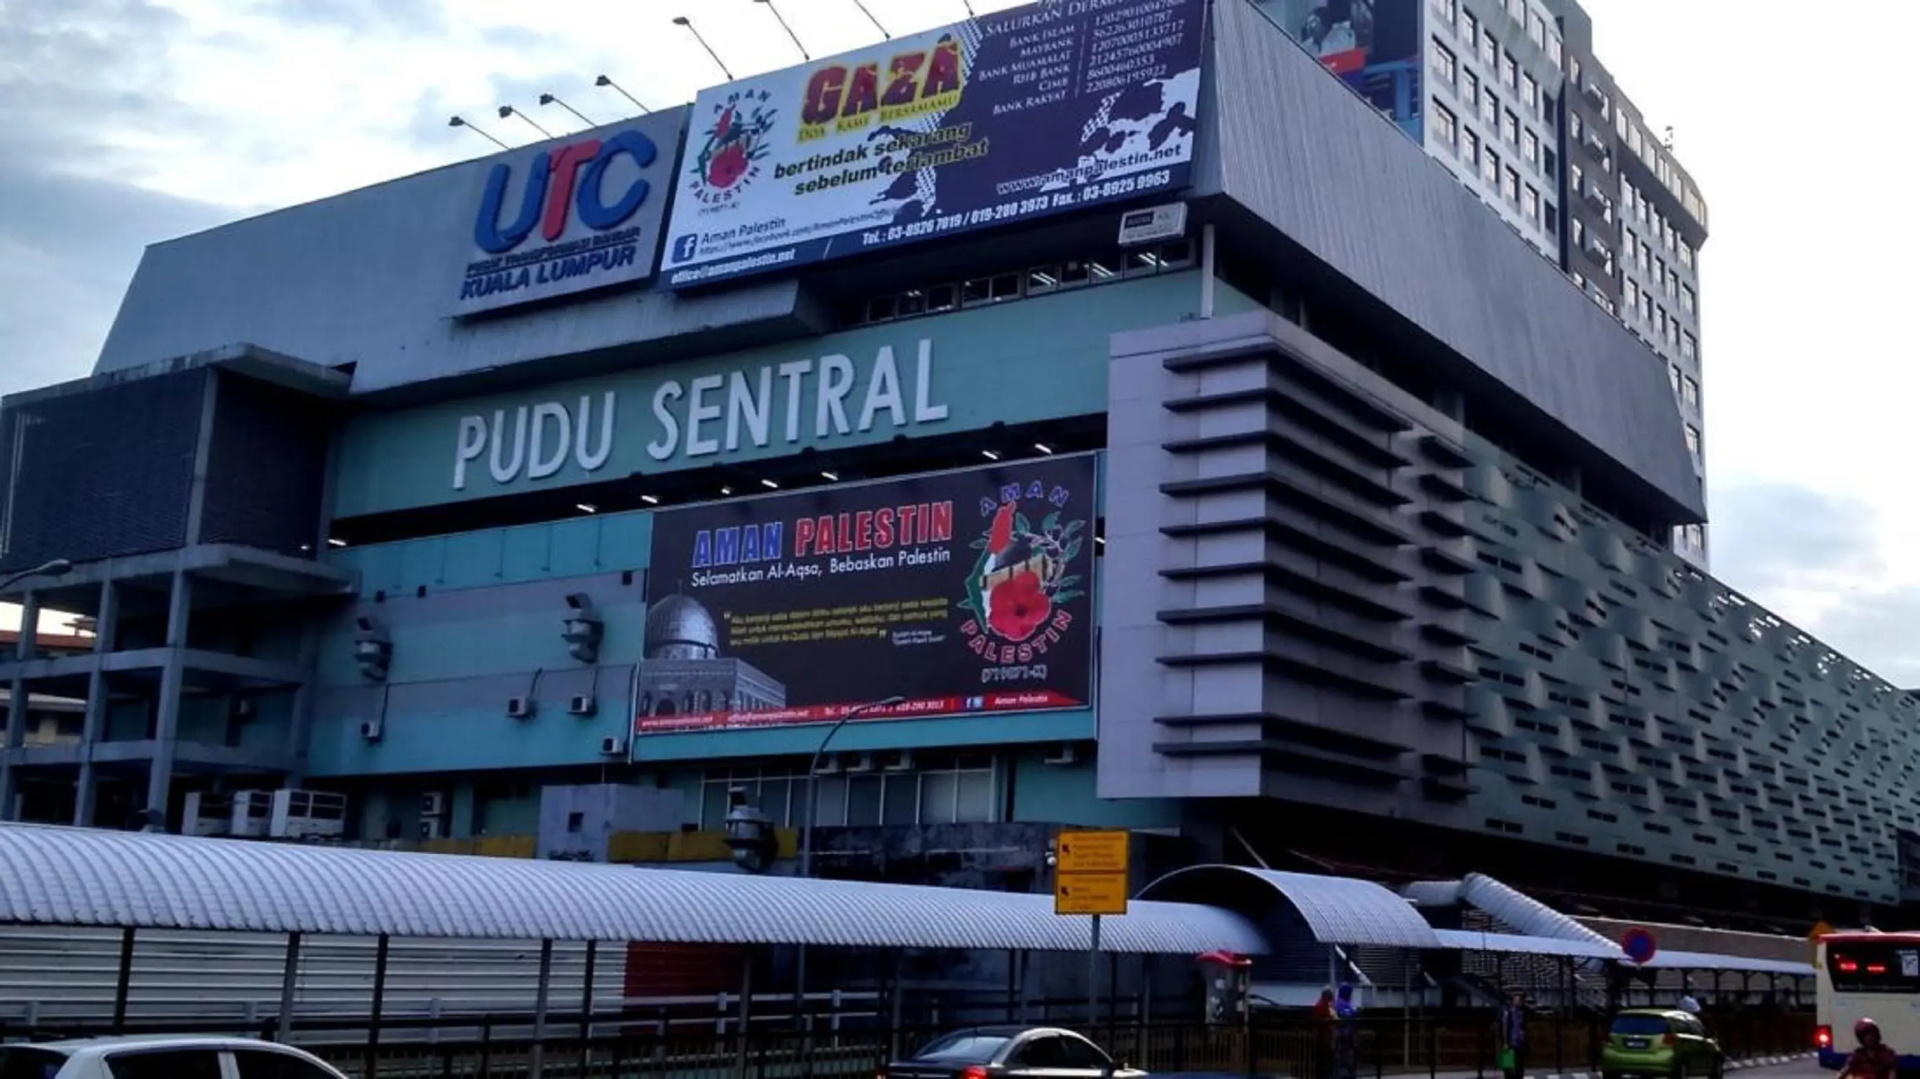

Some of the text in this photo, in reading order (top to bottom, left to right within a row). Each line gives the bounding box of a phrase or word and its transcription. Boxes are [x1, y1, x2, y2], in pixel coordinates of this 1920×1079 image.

[985, 7, 1062, 37] SALURKAN
[1010, 24, 1074, 49] BANK ISLAM
[979, 50, 1072, 81] BANK MUAMALAT
[1021, 38, 1074, 57] MAYBANK
[801, 37, 960, 125] GAZA
[1013, 63, 1070, 84] RHB BANK
[1039, 77, 1068, 91] CIMB
[714, 89, 771, 114] AMAN
[993, 90, 1066, 115] BANK RAKYAT
[774, 122, 973, 179] bertindak sekarang
[795, 137, 989, 195] sebelum terlambat
[996, 144, 1182, 195] www.amanpalestin.net
[474, 130, 657, 253] UTC
[690, 166, 760, 203] PALESTIN
[888, 221, 933, 240] 03-8926
[936, 213, 962, 231] 7019
[1019, 195, 1048, 214] 3973
[1083, 177, 1134, 200] 03-8925
[1136, 170, 1170, 190] 9963
[702, 217, 786, 244] Aman Palestin
[460, 245, 636, 300] KUALA LUMPUR
[453, 338, 949, 489] PUDU SENTRAL
[979, 480, 1070, 517] AMAN
[691, 500, 953, 568] AMAN PALESTIN
[691, 547, 951, 587] Selamatkan Al-Aqsa, Bebaskan Palestin
[961, 608, 1072, 664] PALESTIN
